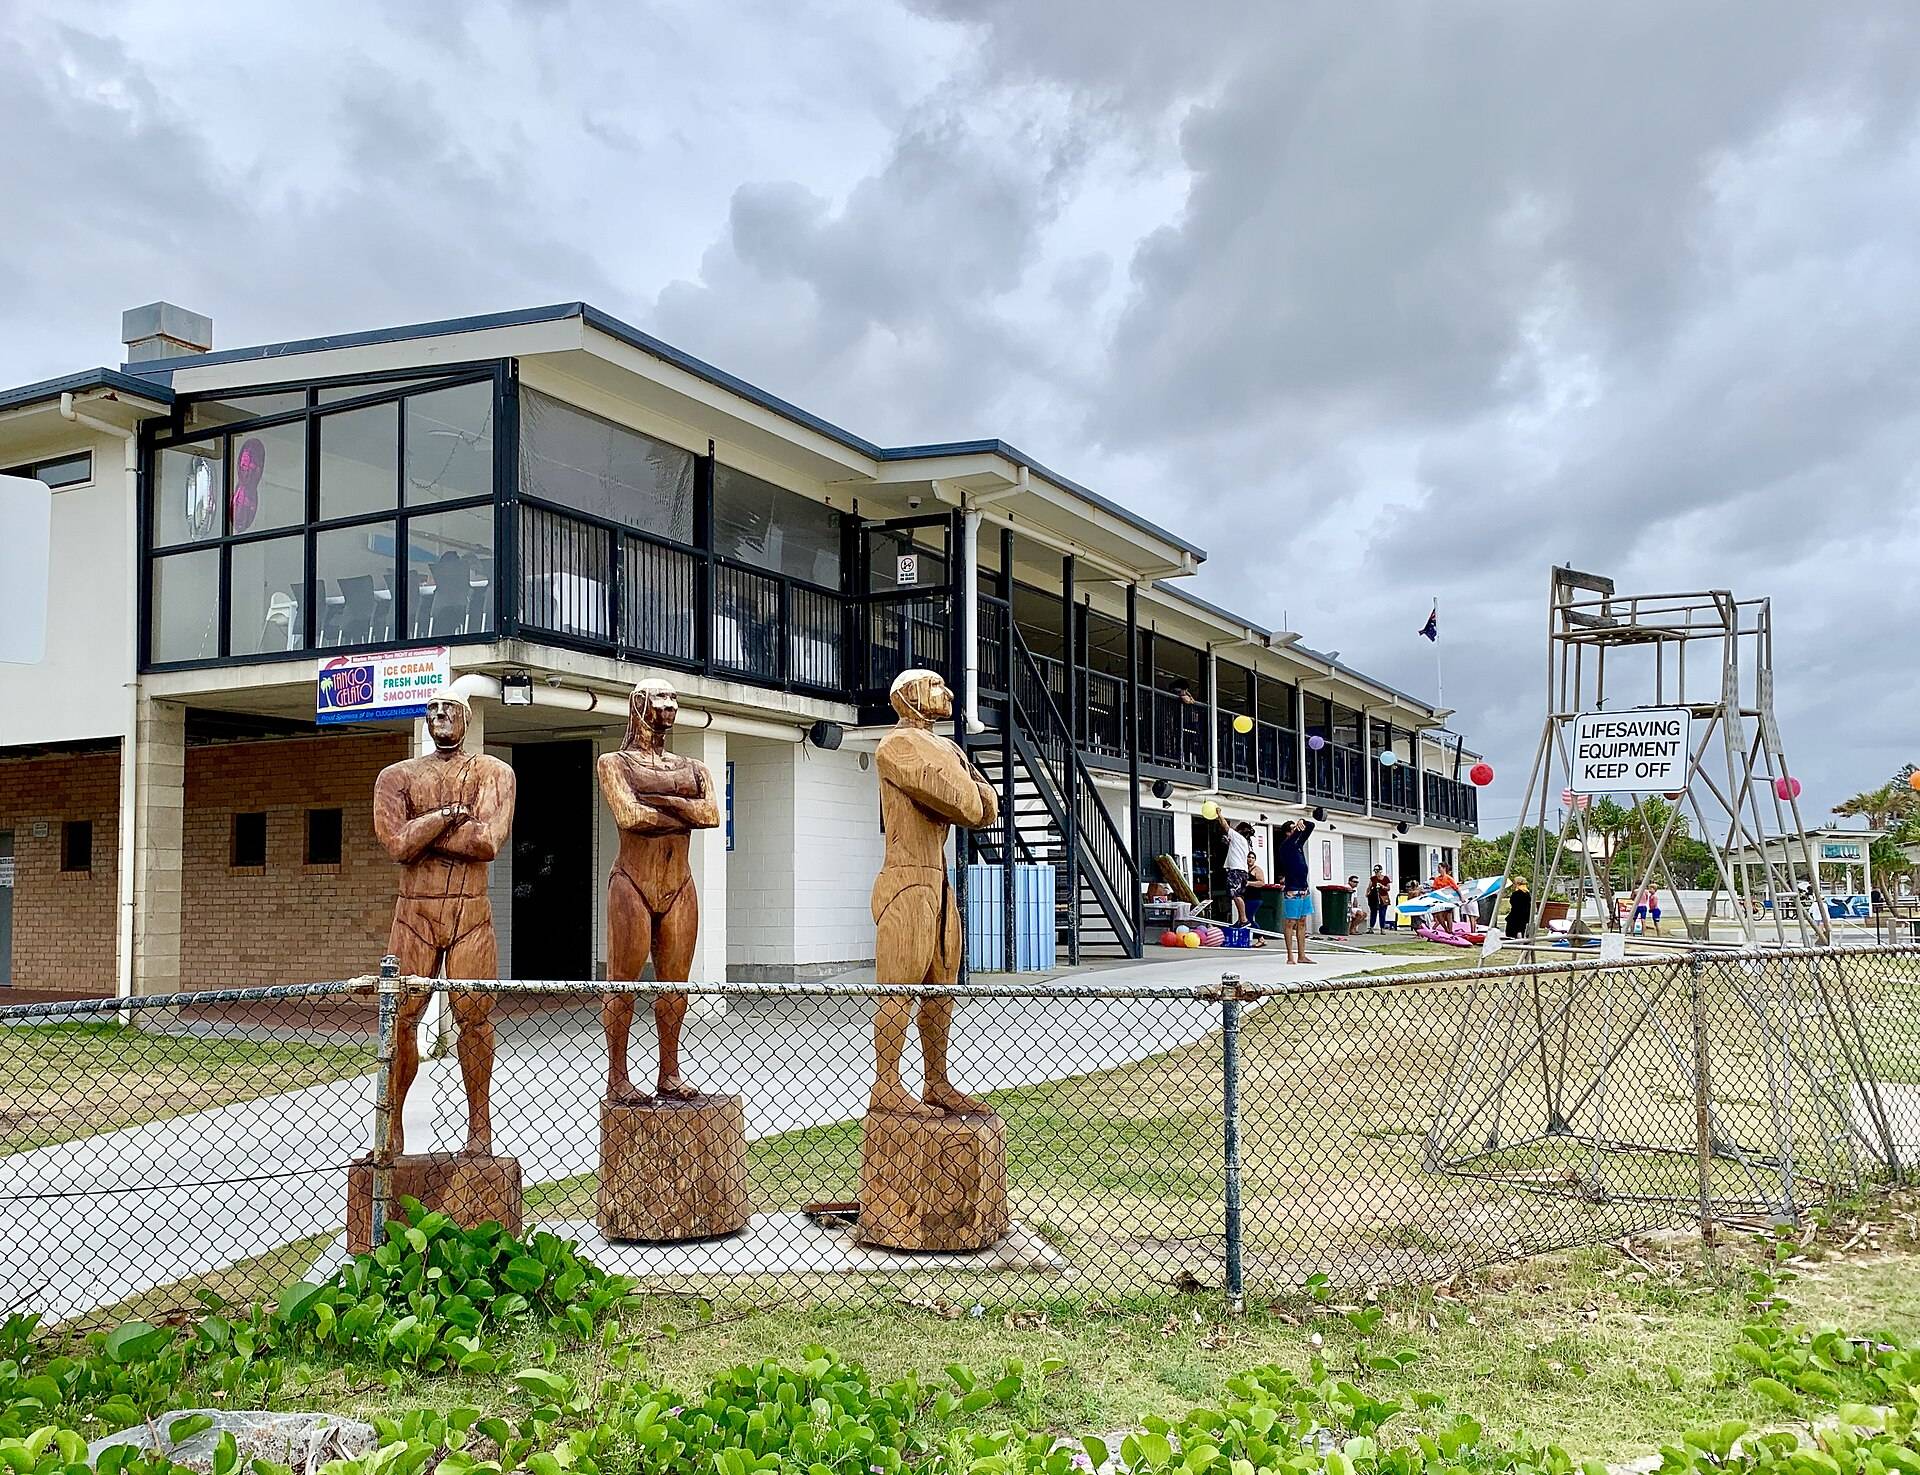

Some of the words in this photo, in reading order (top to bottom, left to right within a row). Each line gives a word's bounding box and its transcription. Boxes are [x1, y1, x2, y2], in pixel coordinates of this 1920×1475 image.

[383, 666, 399, 677] ICE
[400, 661, 434, 675] CREAM
[332, 667, 367, 692] TANGO
[383, 676, 411, 689] FRESH
[414, 673, 443, 686] JUICE
[336, 682, 373, 707] GELATO
[398, 706, 427, 715] HEADLAND
[1582, 720, 1681, 739] LIFESAVING
[1579, 741, 1681, 759] EQUIPMENT
[1584, 763, 1629, 779] KEEP
[1635, 762, 1672, 778] OFF
